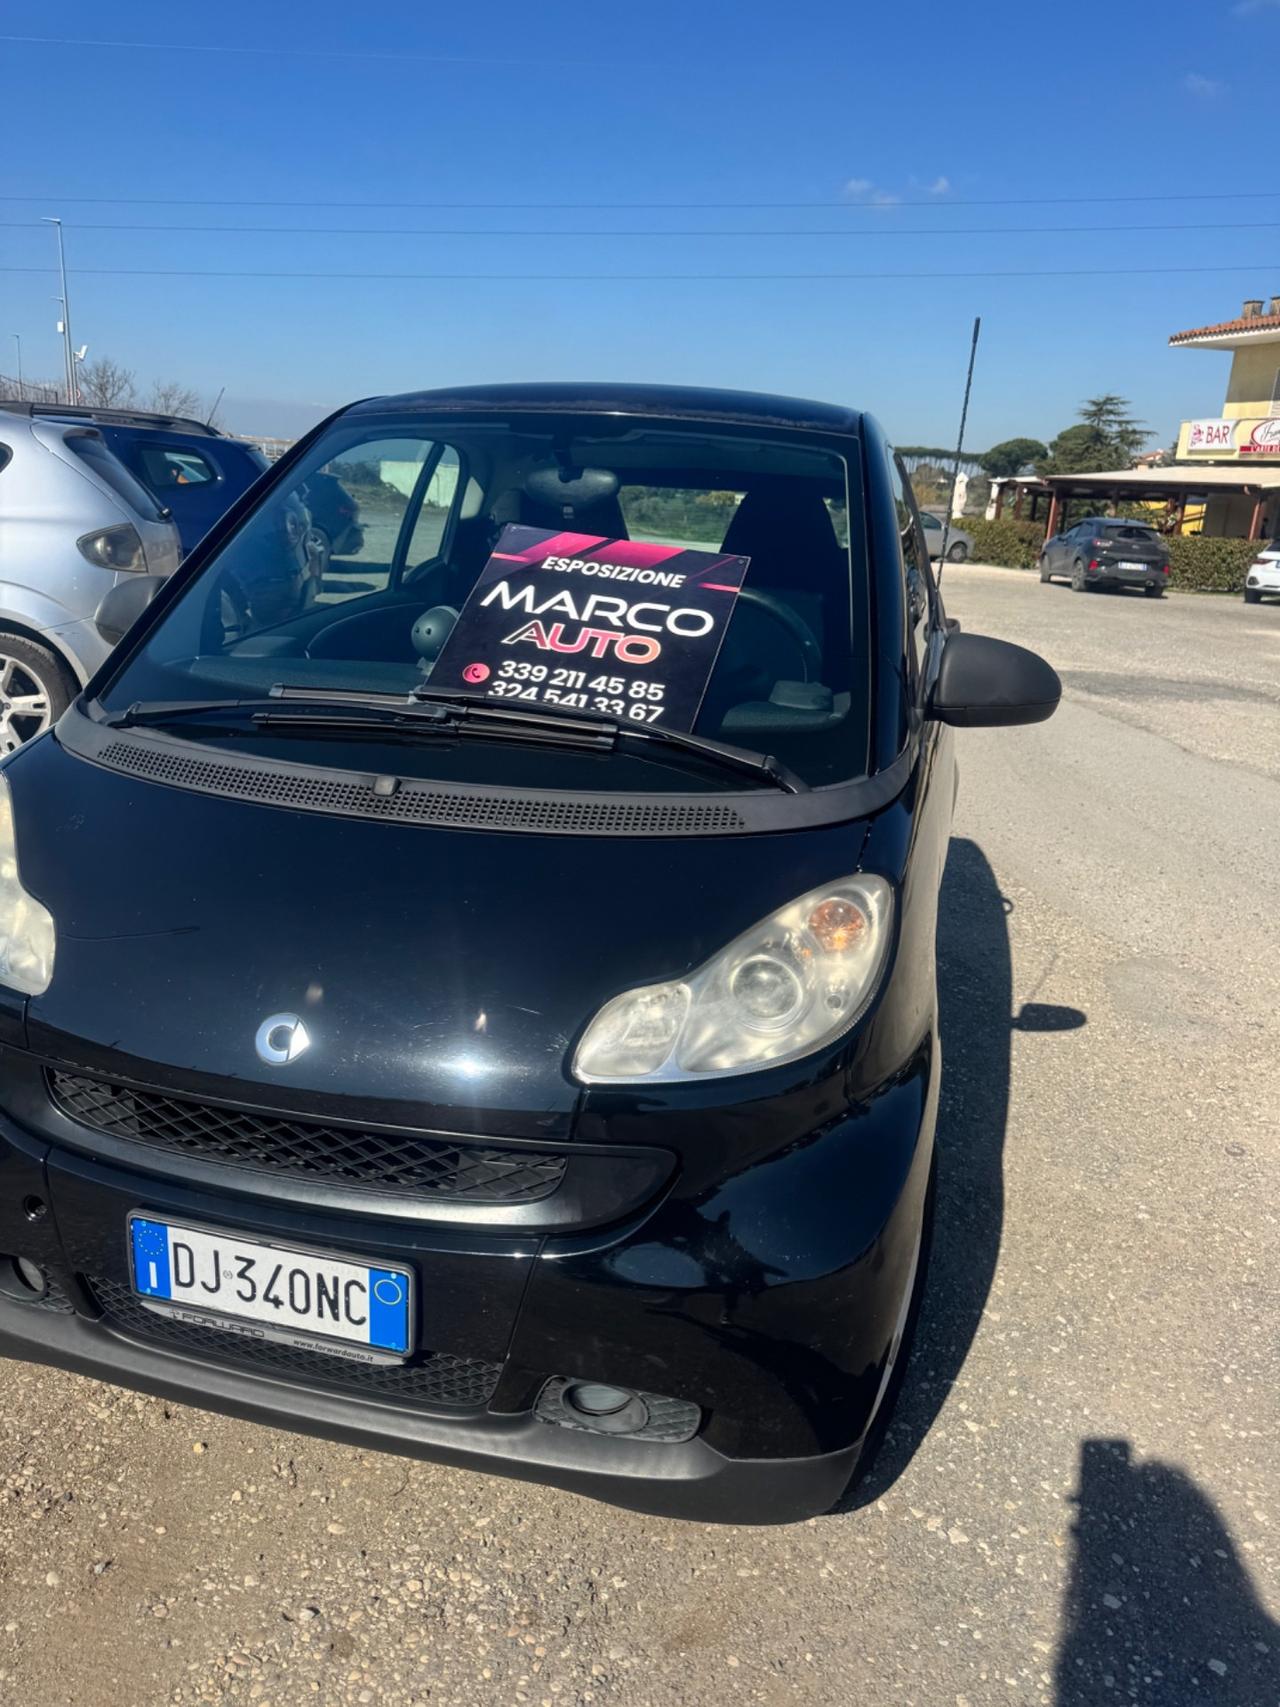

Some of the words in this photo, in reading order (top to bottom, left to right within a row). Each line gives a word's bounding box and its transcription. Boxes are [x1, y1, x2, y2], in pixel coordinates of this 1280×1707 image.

[1206, 426, 1230, 444] BAR
[541, 557, 686, 588] ESPOSIZIONE
[480, 581, 714, 637] MARCO
[502, 620, 661, 664] AUTO
[498, 661, 548, 682] 339
[549, 669, 586, 689] 211
[588, 676, 626, 695] 45
[628, 681, 665, 701] 85
[628, 703, 665, 723] 67
[294, 1339, 374, 1363] www.forwardauto.it
